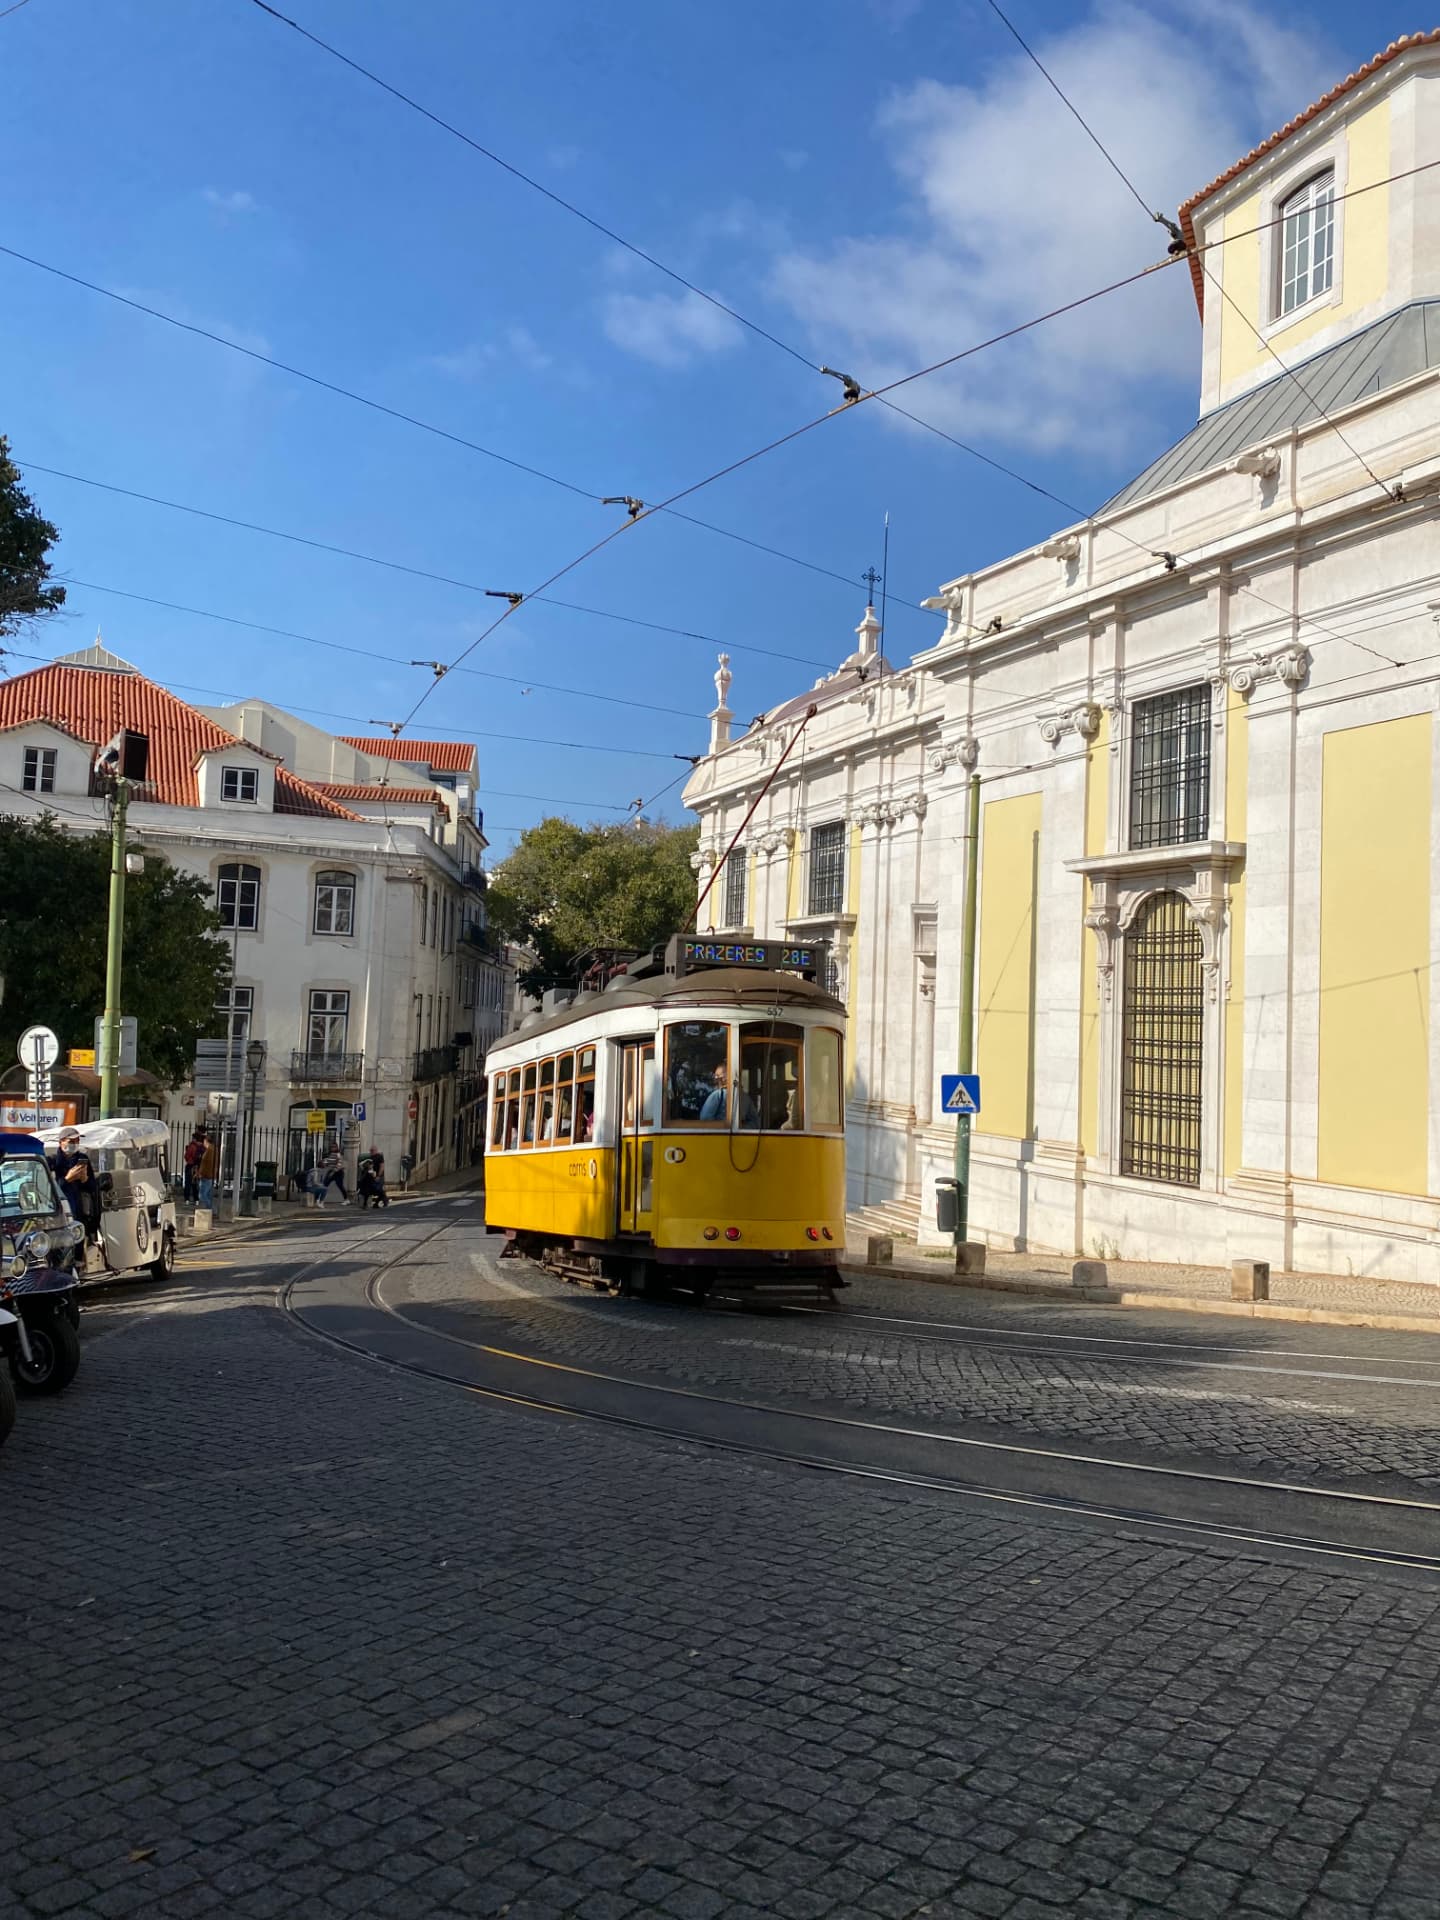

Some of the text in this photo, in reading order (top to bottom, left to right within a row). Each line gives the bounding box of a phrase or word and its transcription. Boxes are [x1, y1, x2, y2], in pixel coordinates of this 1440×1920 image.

[684, 943, 811, 966] PRAZERES 28E
[356, 1104, 364, 1120] P
